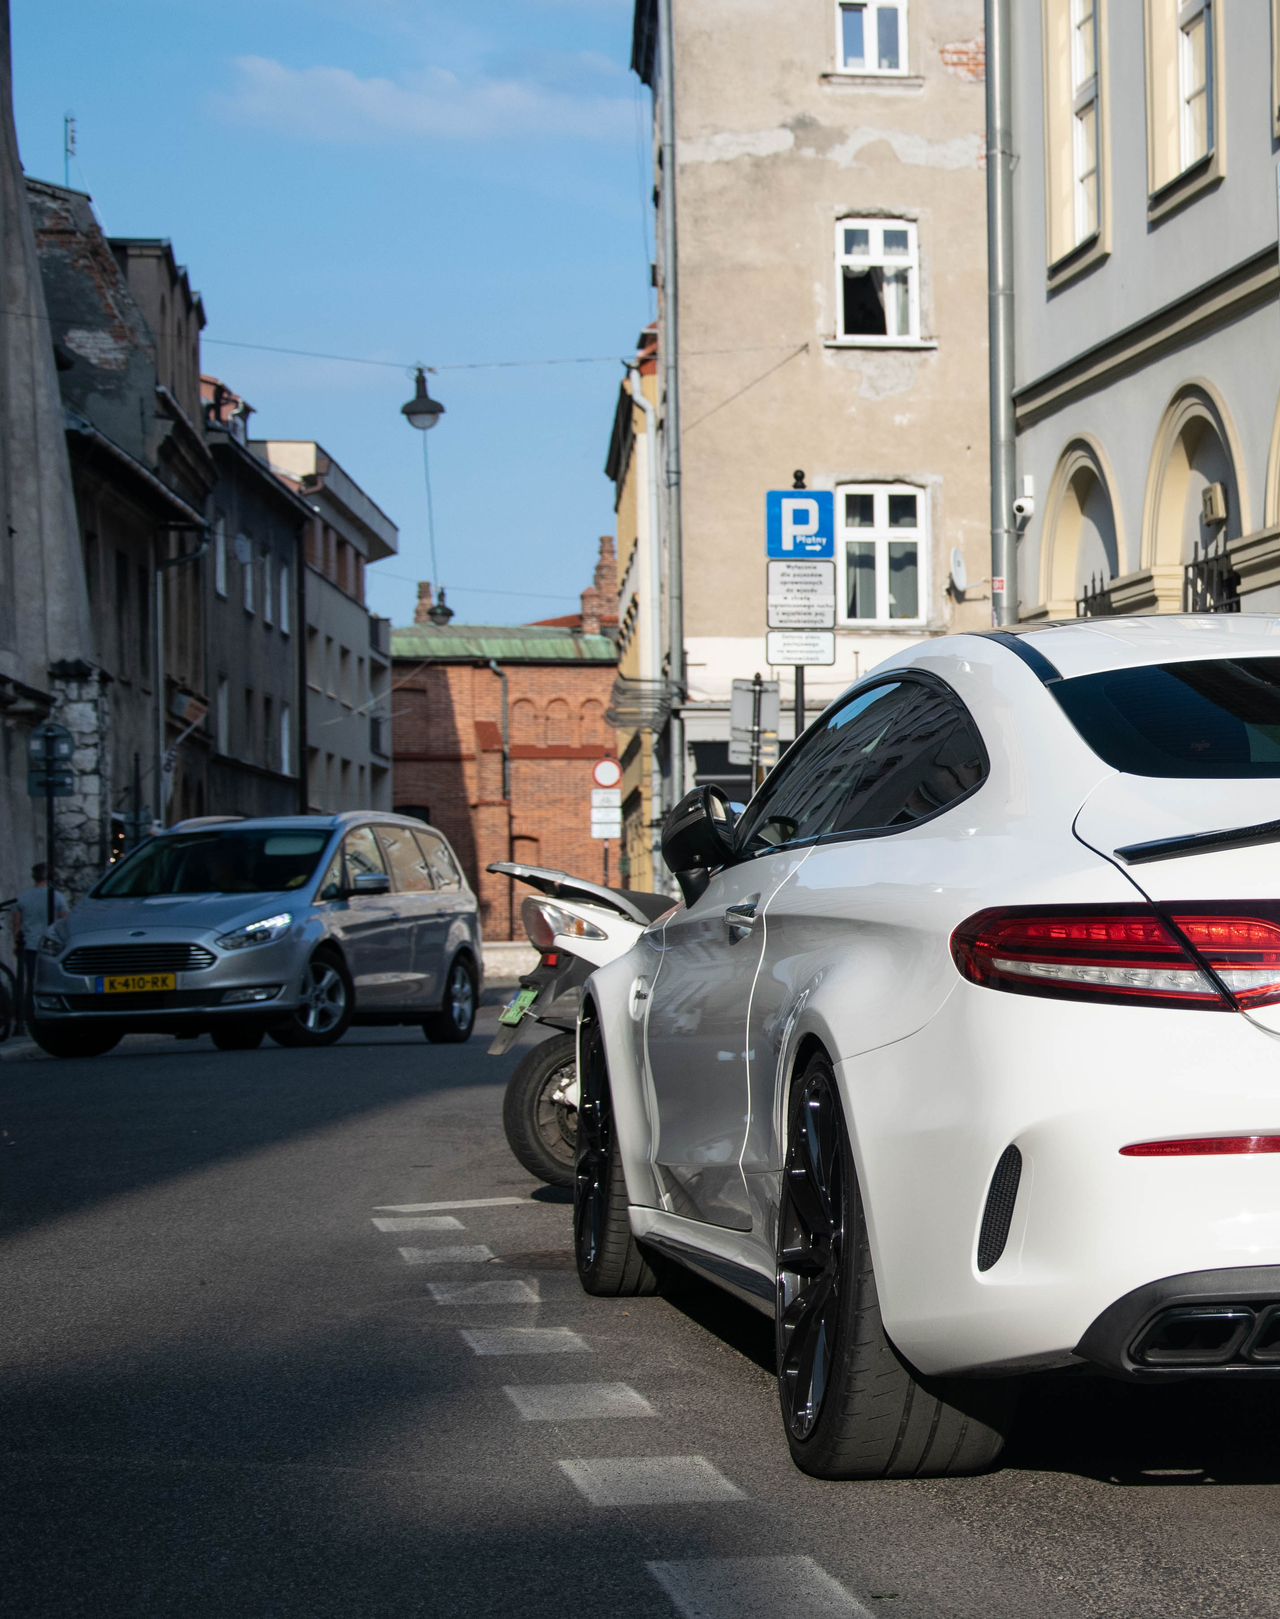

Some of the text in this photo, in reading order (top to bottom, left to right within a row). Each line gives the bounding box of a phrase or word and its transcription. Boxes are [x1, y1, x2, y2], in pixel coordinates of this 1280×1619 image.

[781, 498, 819, 550] P
[796, 535, 827, 546] Płatny
[108, 976, 170, 991] K-410-RK
